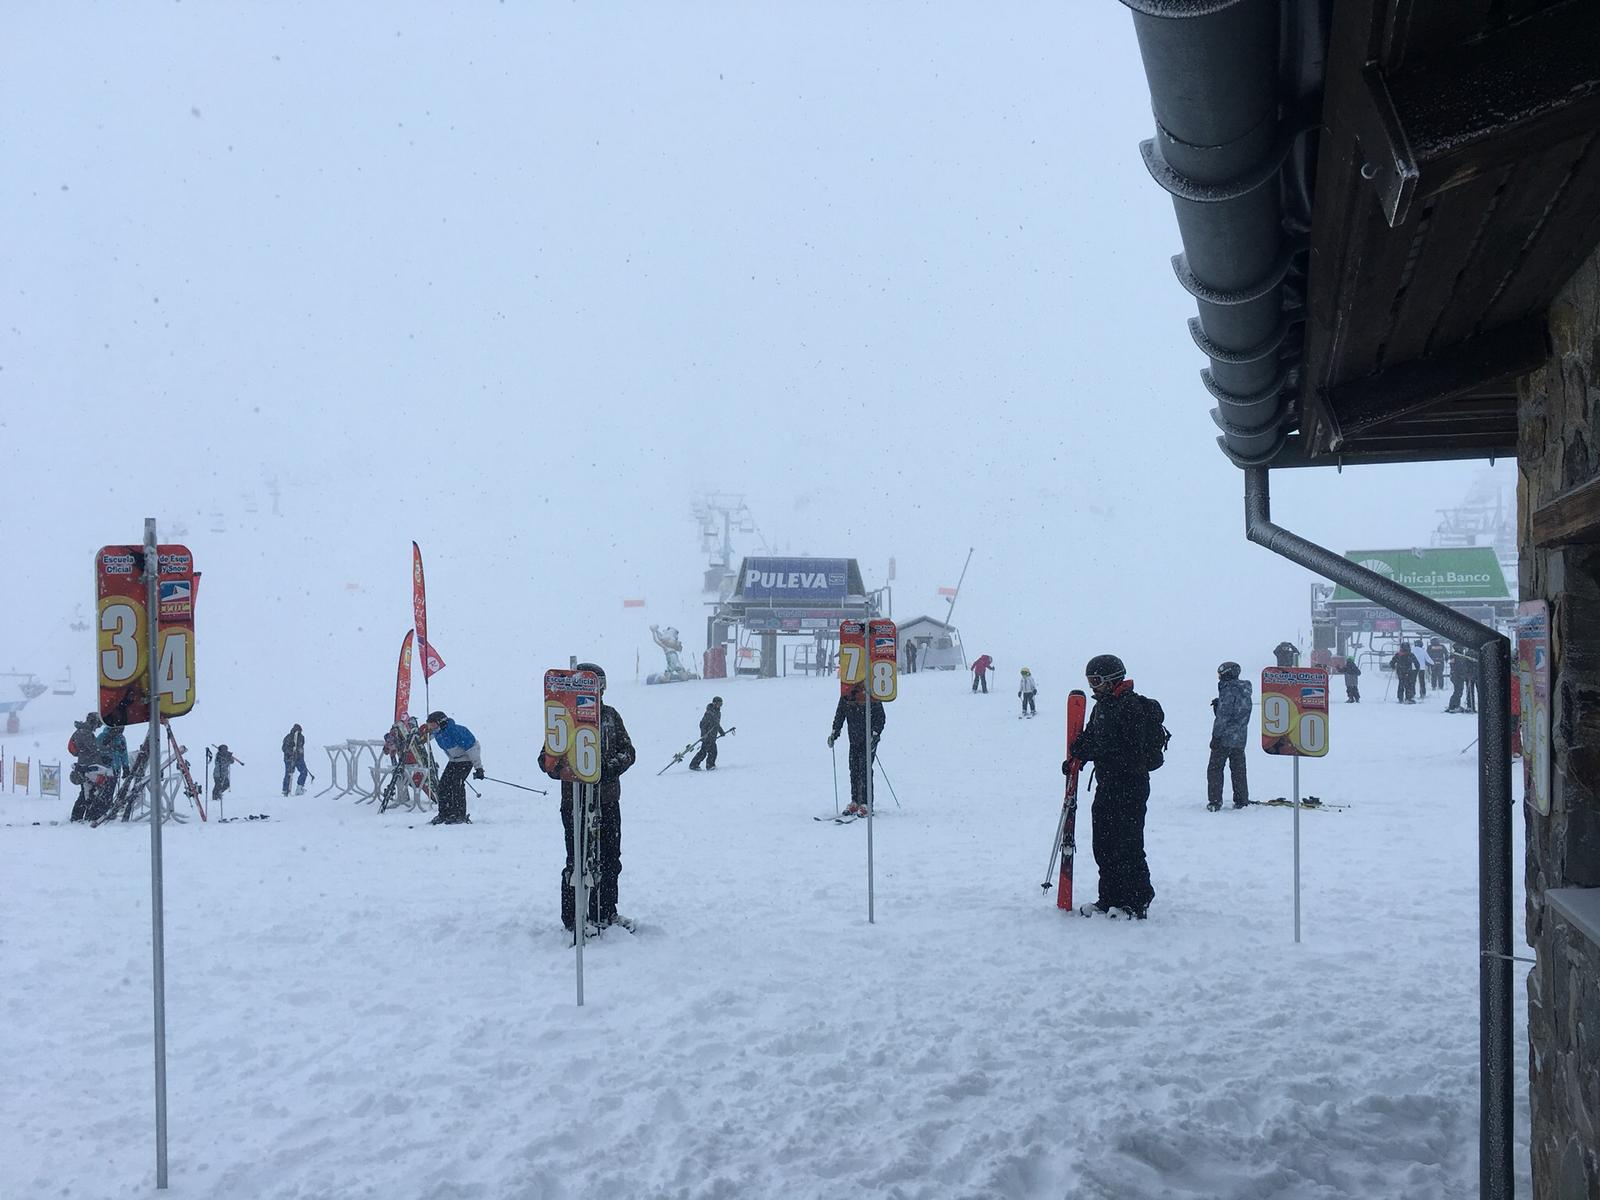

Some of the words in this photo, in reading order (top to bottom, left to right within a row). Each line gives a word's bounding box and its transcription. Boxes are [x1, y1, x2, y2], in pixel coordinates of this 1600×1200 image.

[103, 555, 134, 564] Escuela
[106, 565, 131, 573] Oficial
[159, 555, 169, 563] de
[745, 569, 828, 588] PULEVA
[1390, 571, 1444, 585] Unicaja
[1446, 571, 1490, 583] Banco
[101, 604, 138, 681] 3
[158, 634, 190, 704] 4
[843, 647, 861, 682] 7
[872, 662, 894, 697] 8
[1298, 672, 1326, 680] Oficial
[546, 705, 568, 753] 5
[1264, 695, 1290, 734] 9
[1299, 713, 1326, 752] 0
[575, 728, 597, 777] 6
